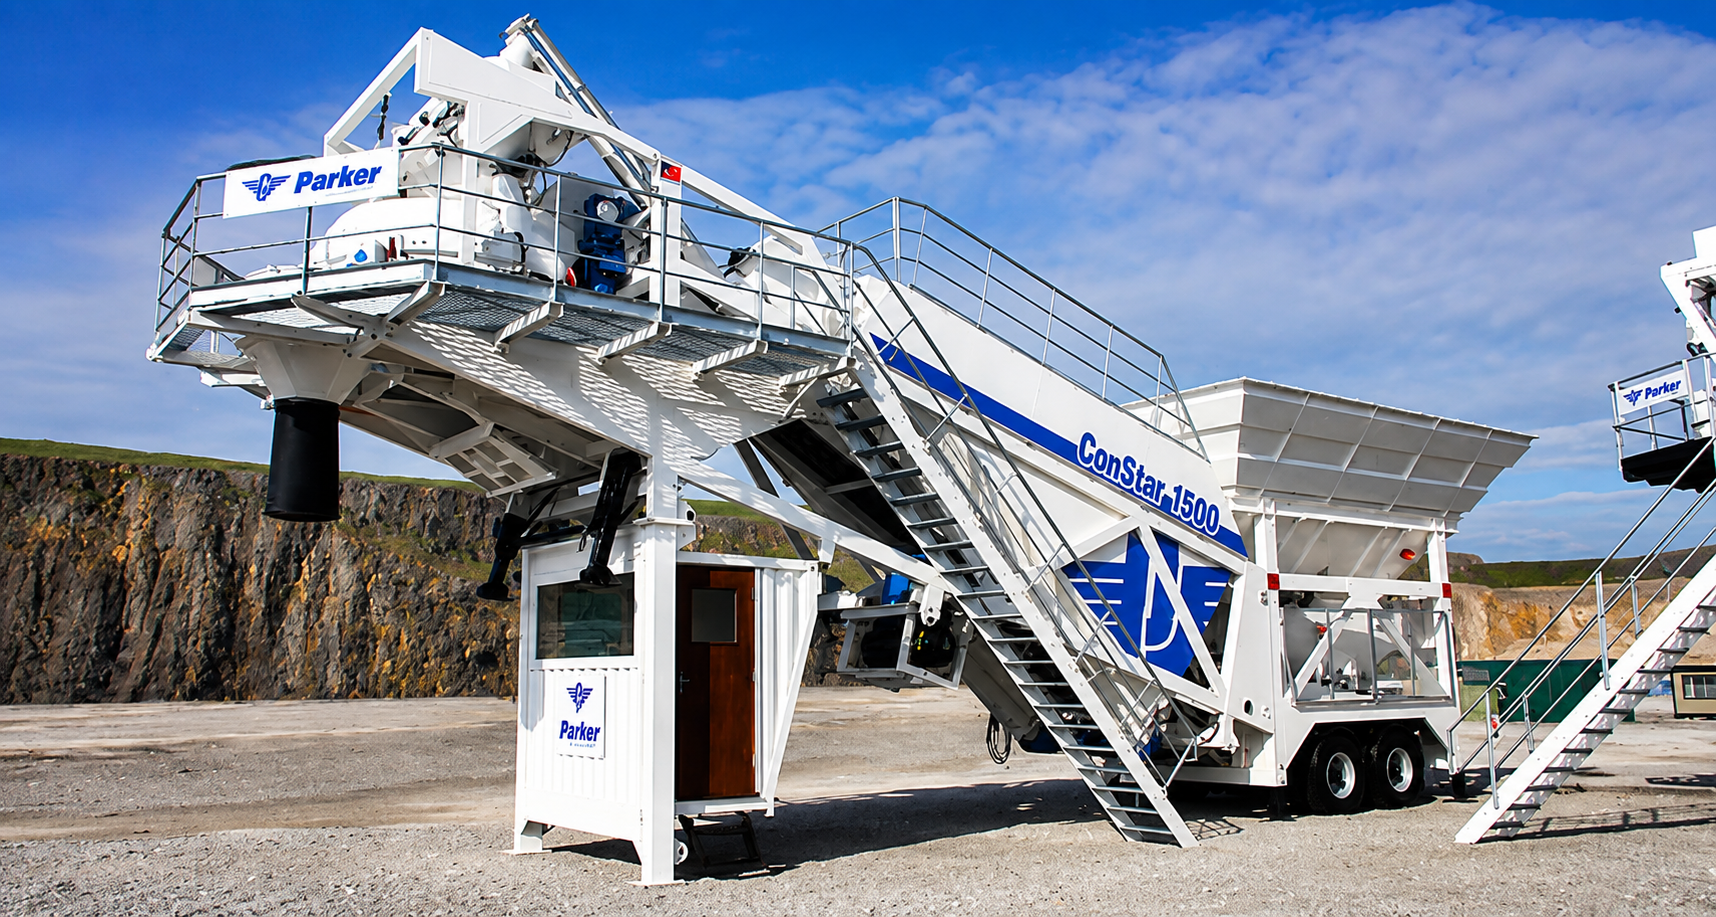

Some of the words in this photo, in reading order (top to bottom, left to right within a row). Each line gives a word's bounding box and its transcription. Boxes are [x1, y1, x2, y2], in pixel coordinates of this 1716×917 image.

[294, 165, 382, 194] Parker
[1645, 380, 1681, 400] Parker
[1079, 432, 1166, 503] ConStar
[1172, 484, 1220, 534] 1500
[559, 720, 601, 742] Parker
